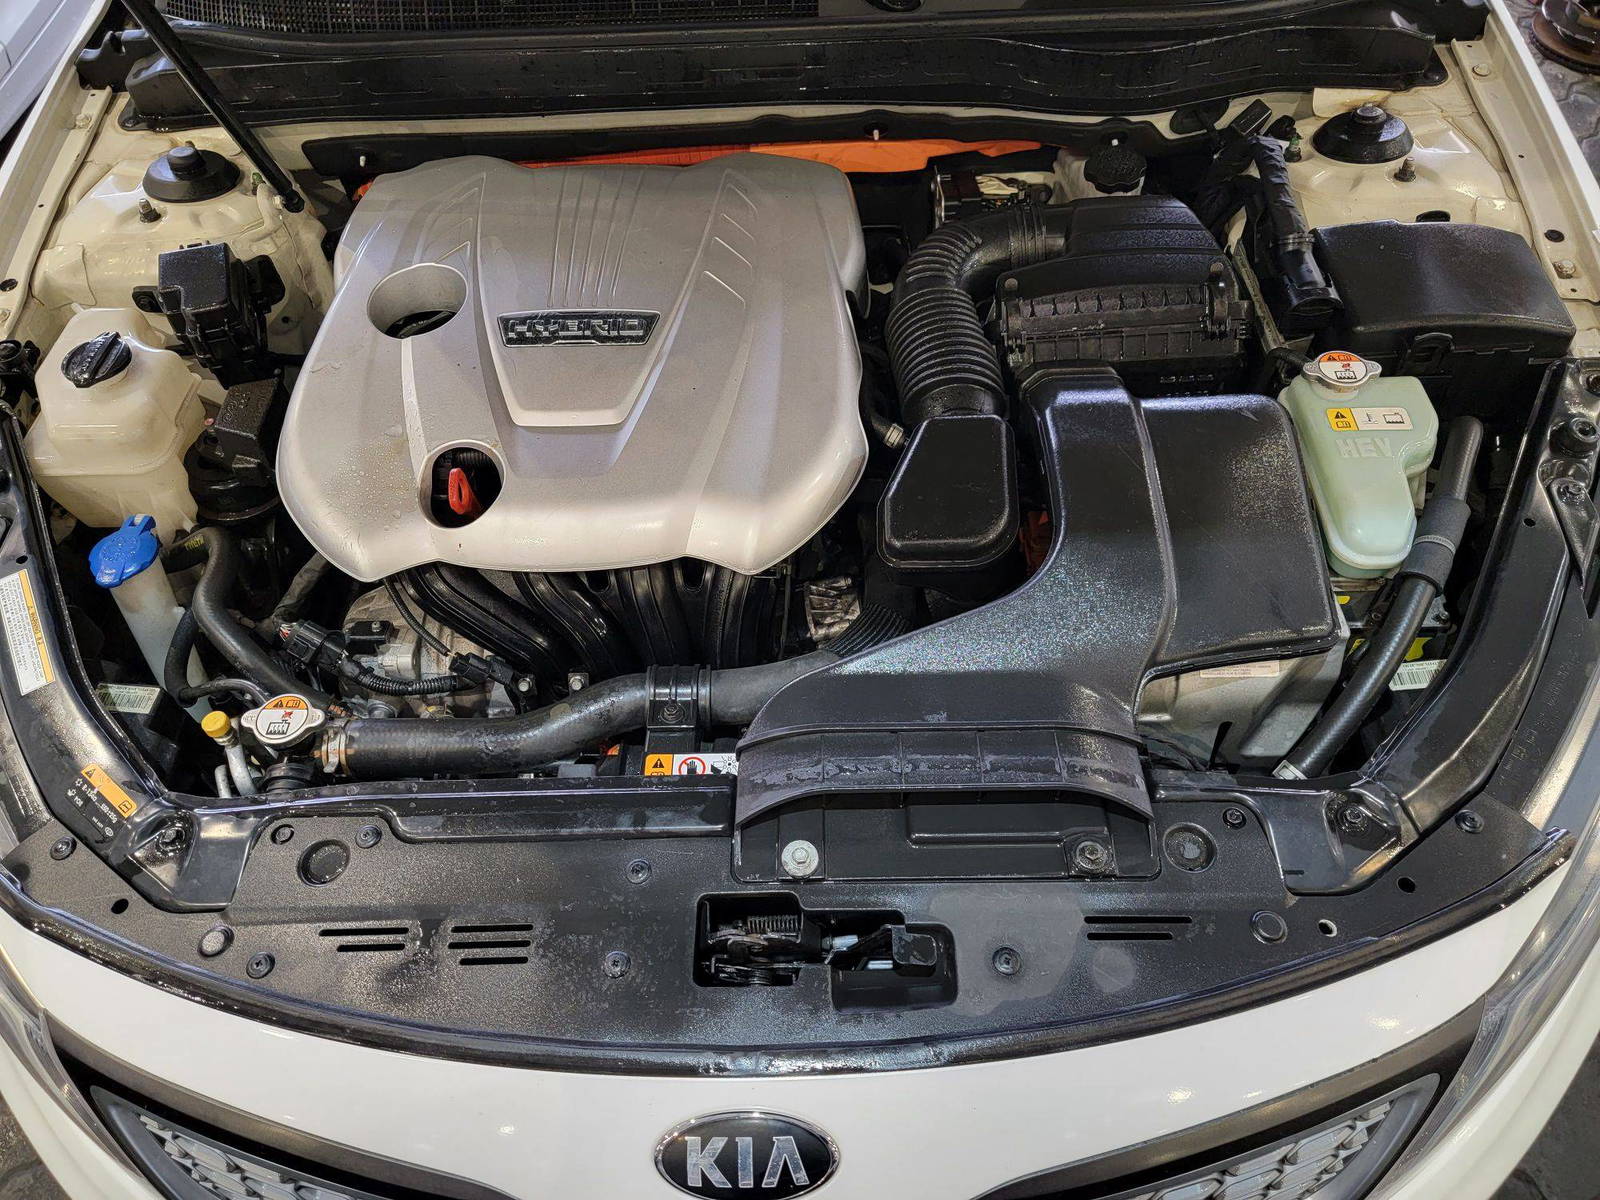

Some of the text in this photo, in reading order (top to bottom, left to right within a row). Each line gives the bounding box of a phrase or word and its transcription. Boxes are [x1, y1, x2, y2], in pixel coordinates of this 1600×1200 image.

[508, 318, 648, 339] HYBRID
[1335, 436, 1393, 459] HEV
[684, 1135, 810, 1188] KIA
